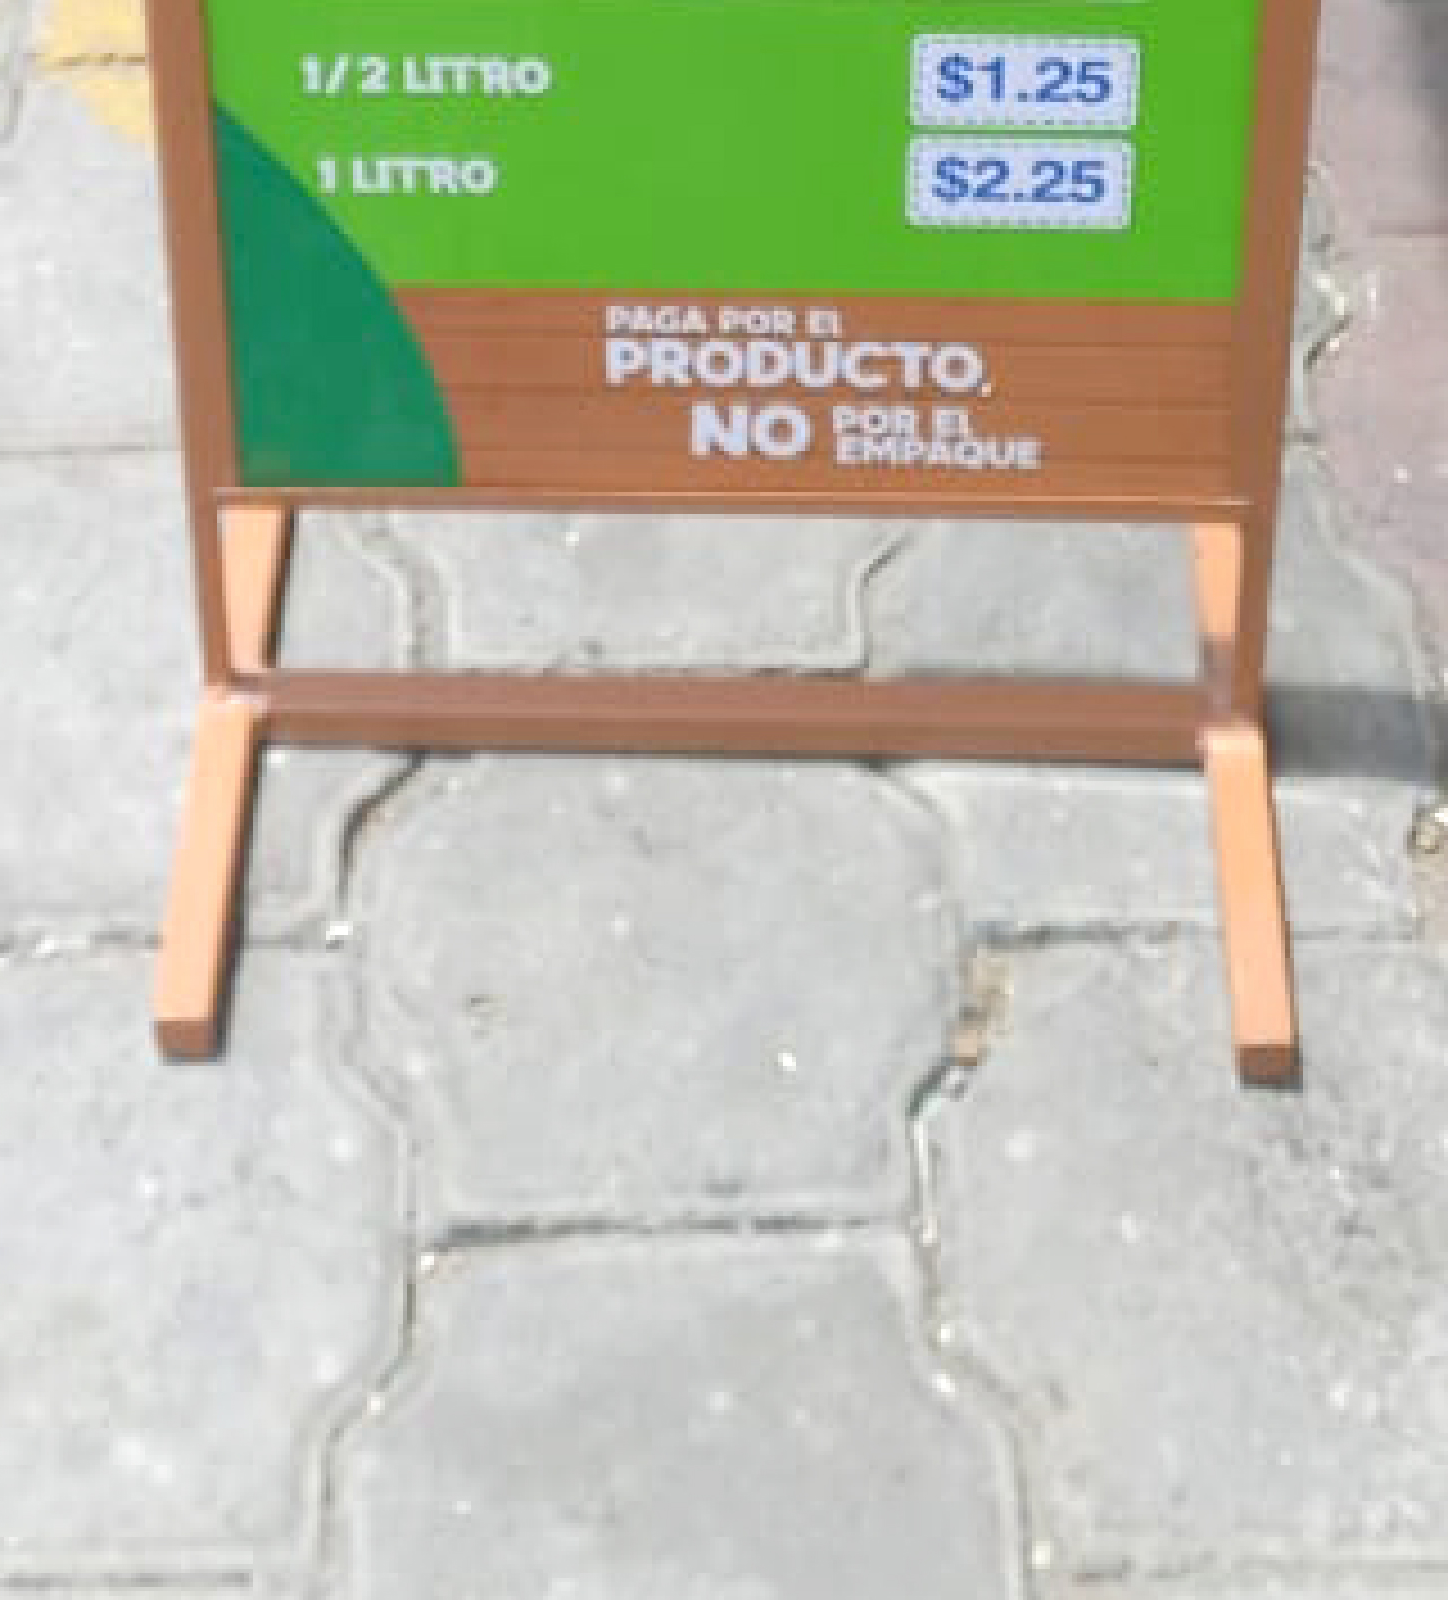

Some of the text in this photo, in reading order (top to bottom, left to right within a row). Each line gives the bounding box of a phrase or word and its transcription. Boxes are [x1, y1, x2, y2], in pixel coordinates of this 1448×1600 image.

[302, 56, 1110, 103] 1/2 LITRO $1.25
[352, 156, 494, 194] LITRO
[936, 160, 1105, 203] $2.25
[605, 305, 707, 334] PAGA
[718, 305, 797, 334] POR
[691, 400, 811, 456] NO
[832, 405, 920, 440] POR
[836, 438, 1038, 470] EMPAQUE
